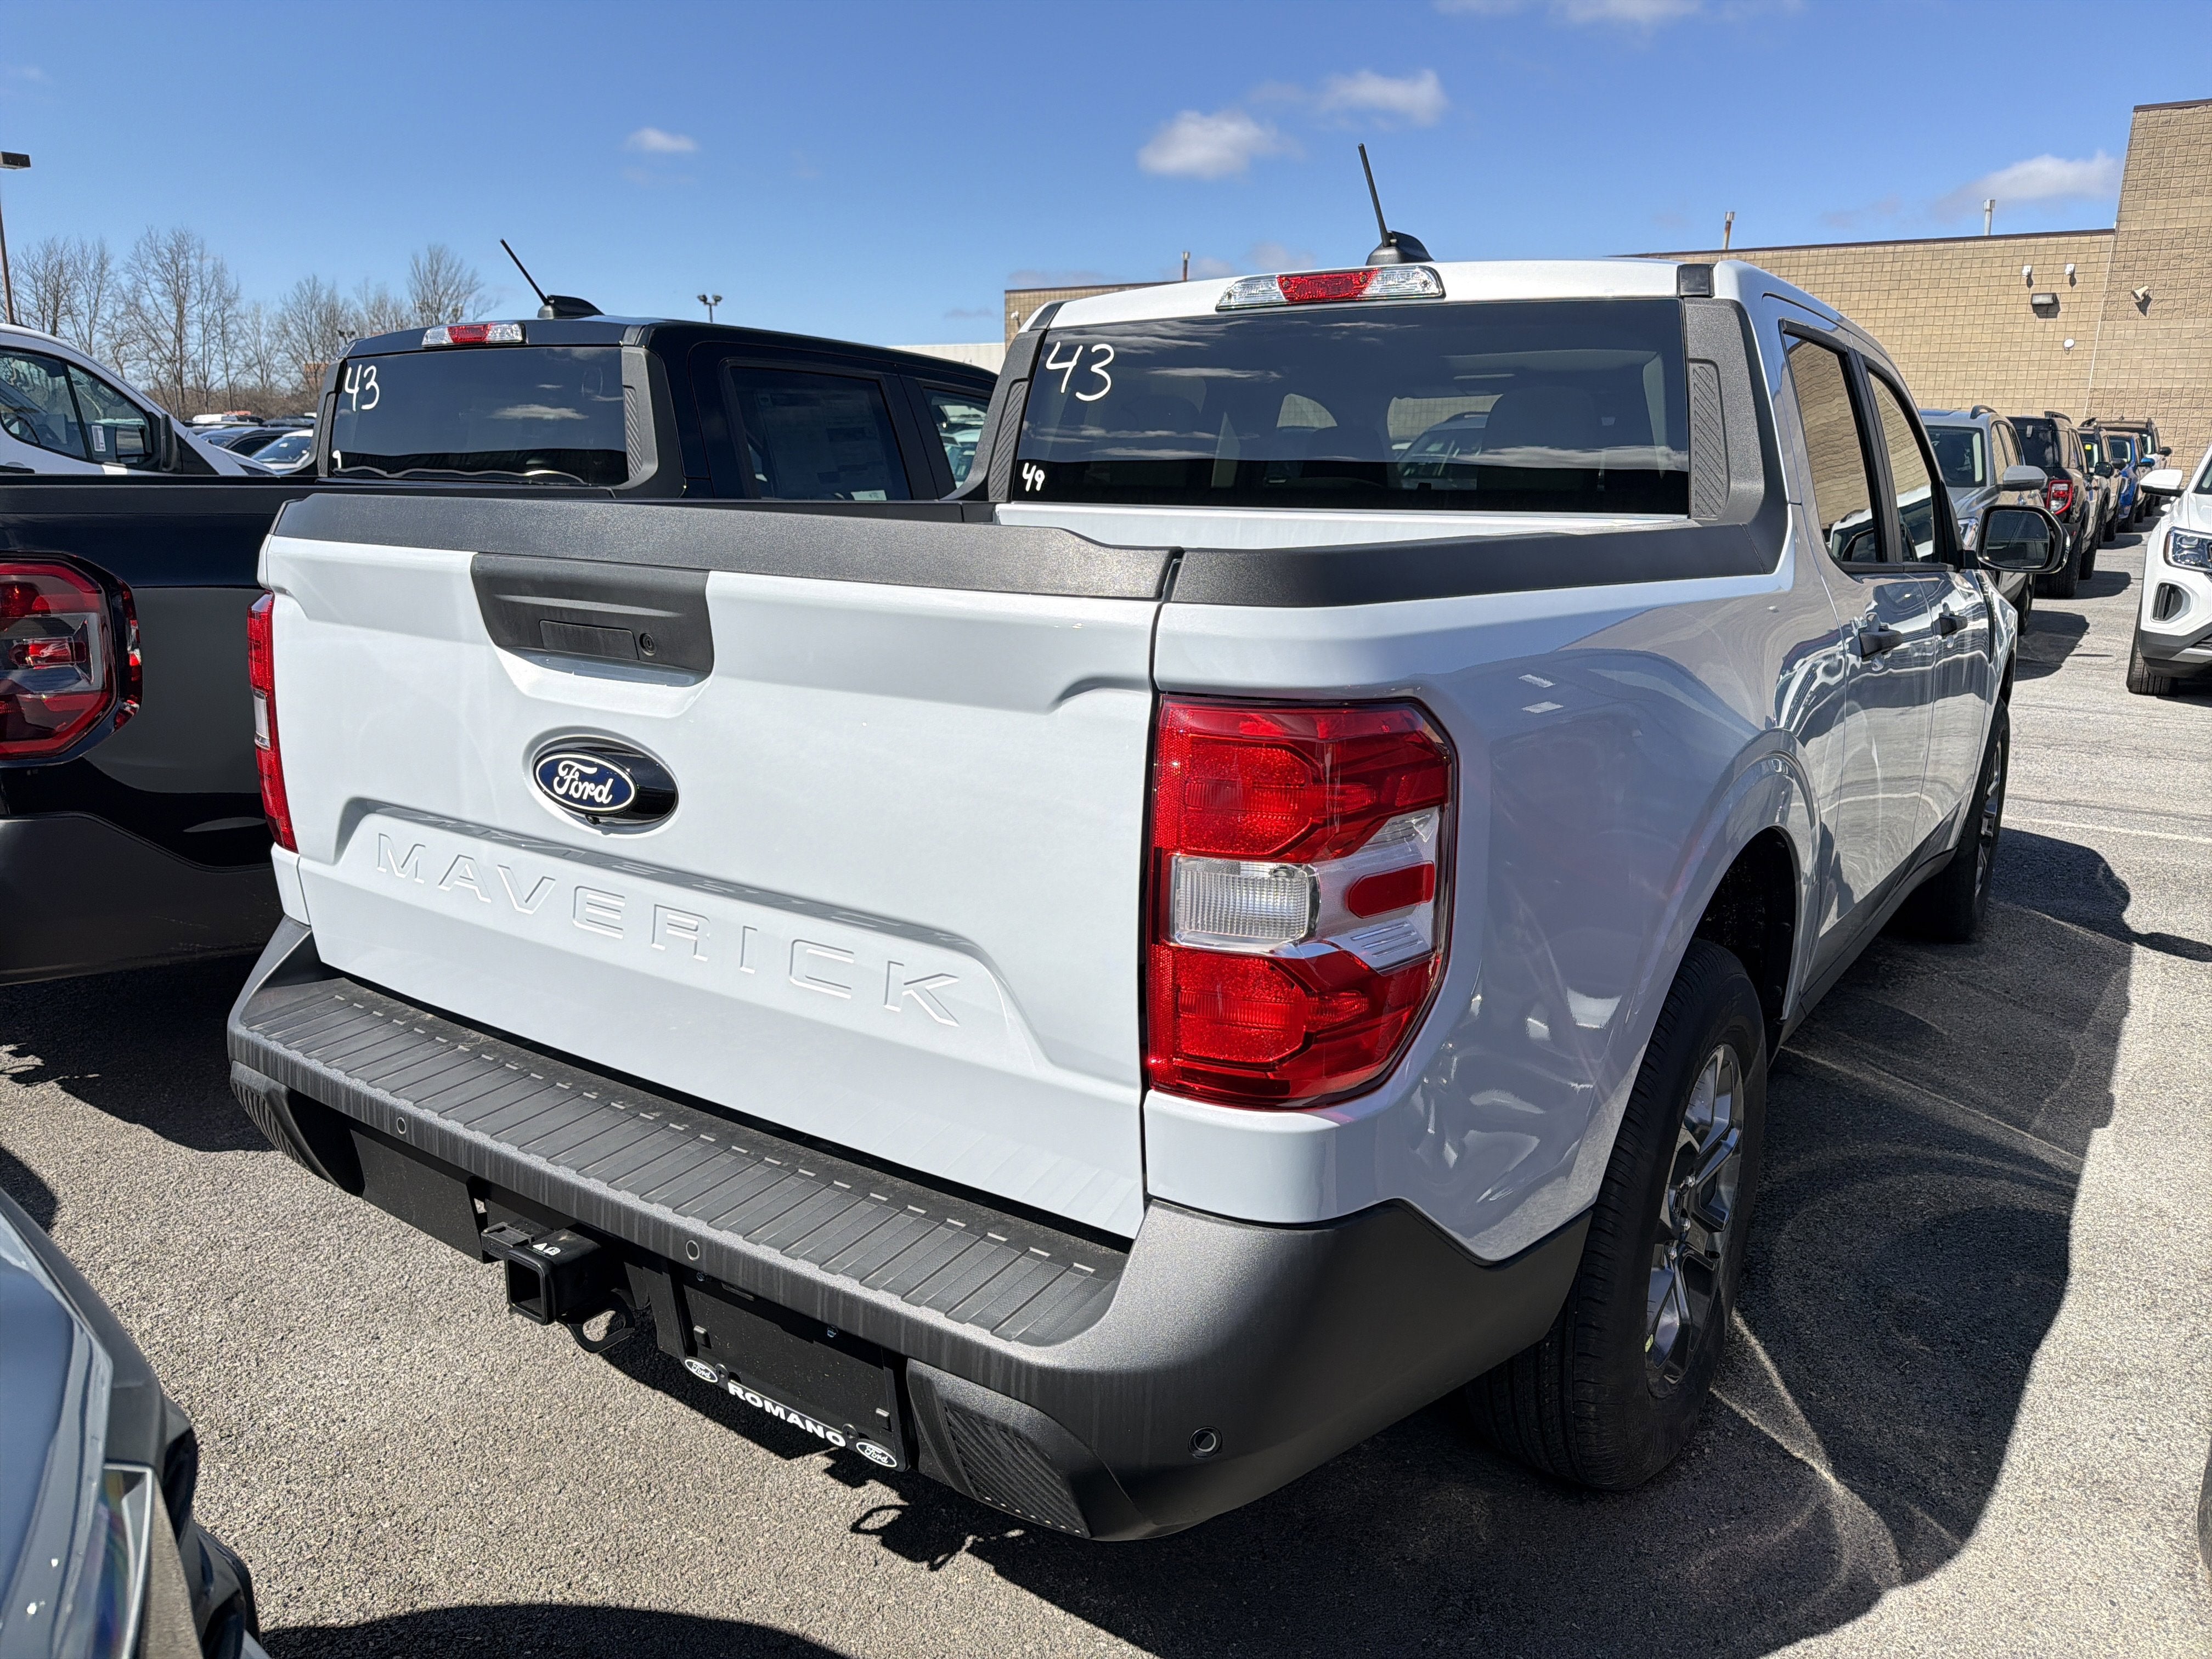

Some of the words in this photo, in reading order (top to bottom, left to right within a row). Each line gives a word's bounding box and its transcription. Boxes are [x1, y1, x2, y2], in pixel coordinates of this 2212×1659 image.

[345, 364, 380, 413] 43
[1046, 341, 1115, 402] 43
[1022, 462, 1045, 492] 49
[553, 760, 613, 804] Ford
[377, 832, 961, 1028] MAVERICK
[691, 1363, 711, 1380] Ford
[727, 1381, 847, 1447] ROMANO
[864, 1446, 889, 1464] Ford
